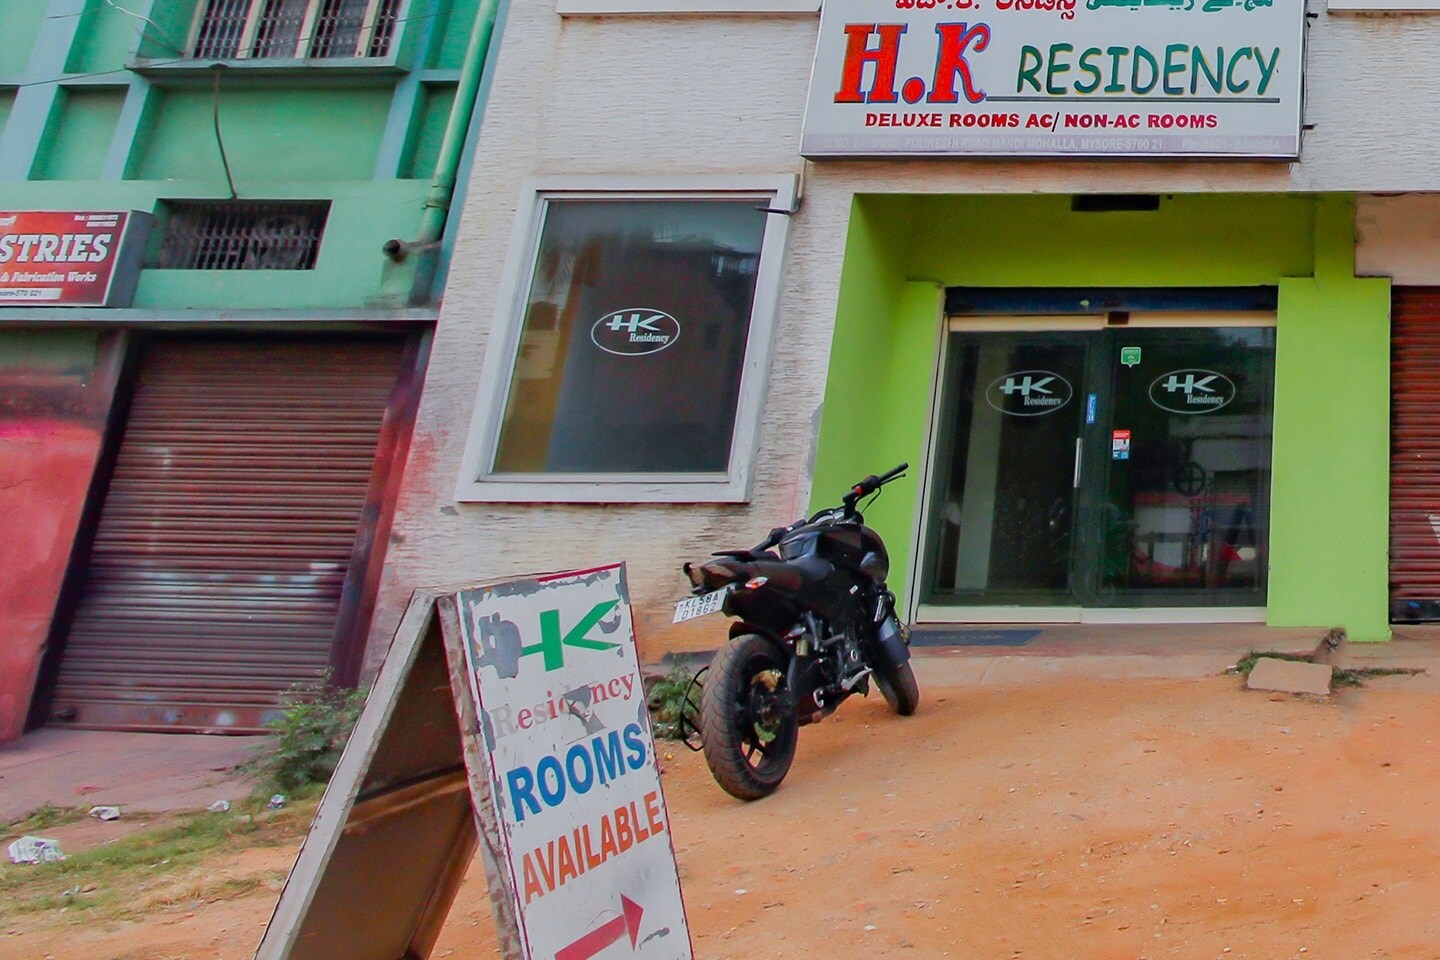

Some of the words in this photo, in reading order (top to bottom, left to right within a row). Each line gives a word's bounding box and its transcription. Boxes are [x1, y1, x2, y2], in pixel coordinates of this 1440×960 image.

[833, 21, 991, 105] H.K
[1016, 42, 1280, 96] RESIDENCY
[865, 113, 942, 128] DELUXE
[949, 113, 1020, 128] ROOMS
[1064, 114, 1141, 129] NON-AC
[1147, 114, 1218, 129] ROOMS
[0, 233, 112, 263] STRIES
[10, 271, 65, 283] Fabrication
[67, 271, 97, 283] Works
[605, 313, 665, 332] HK
[629, 333, 670, 344] Residency
[998, 376, 1056, 396] HK
[1162, 374, 1219, 394] HK
[1186, 393, 1224, 406] Residency
[506, 722, 647, 822] ROOMS
[521, 790, 665, 905] AVAILABLE
